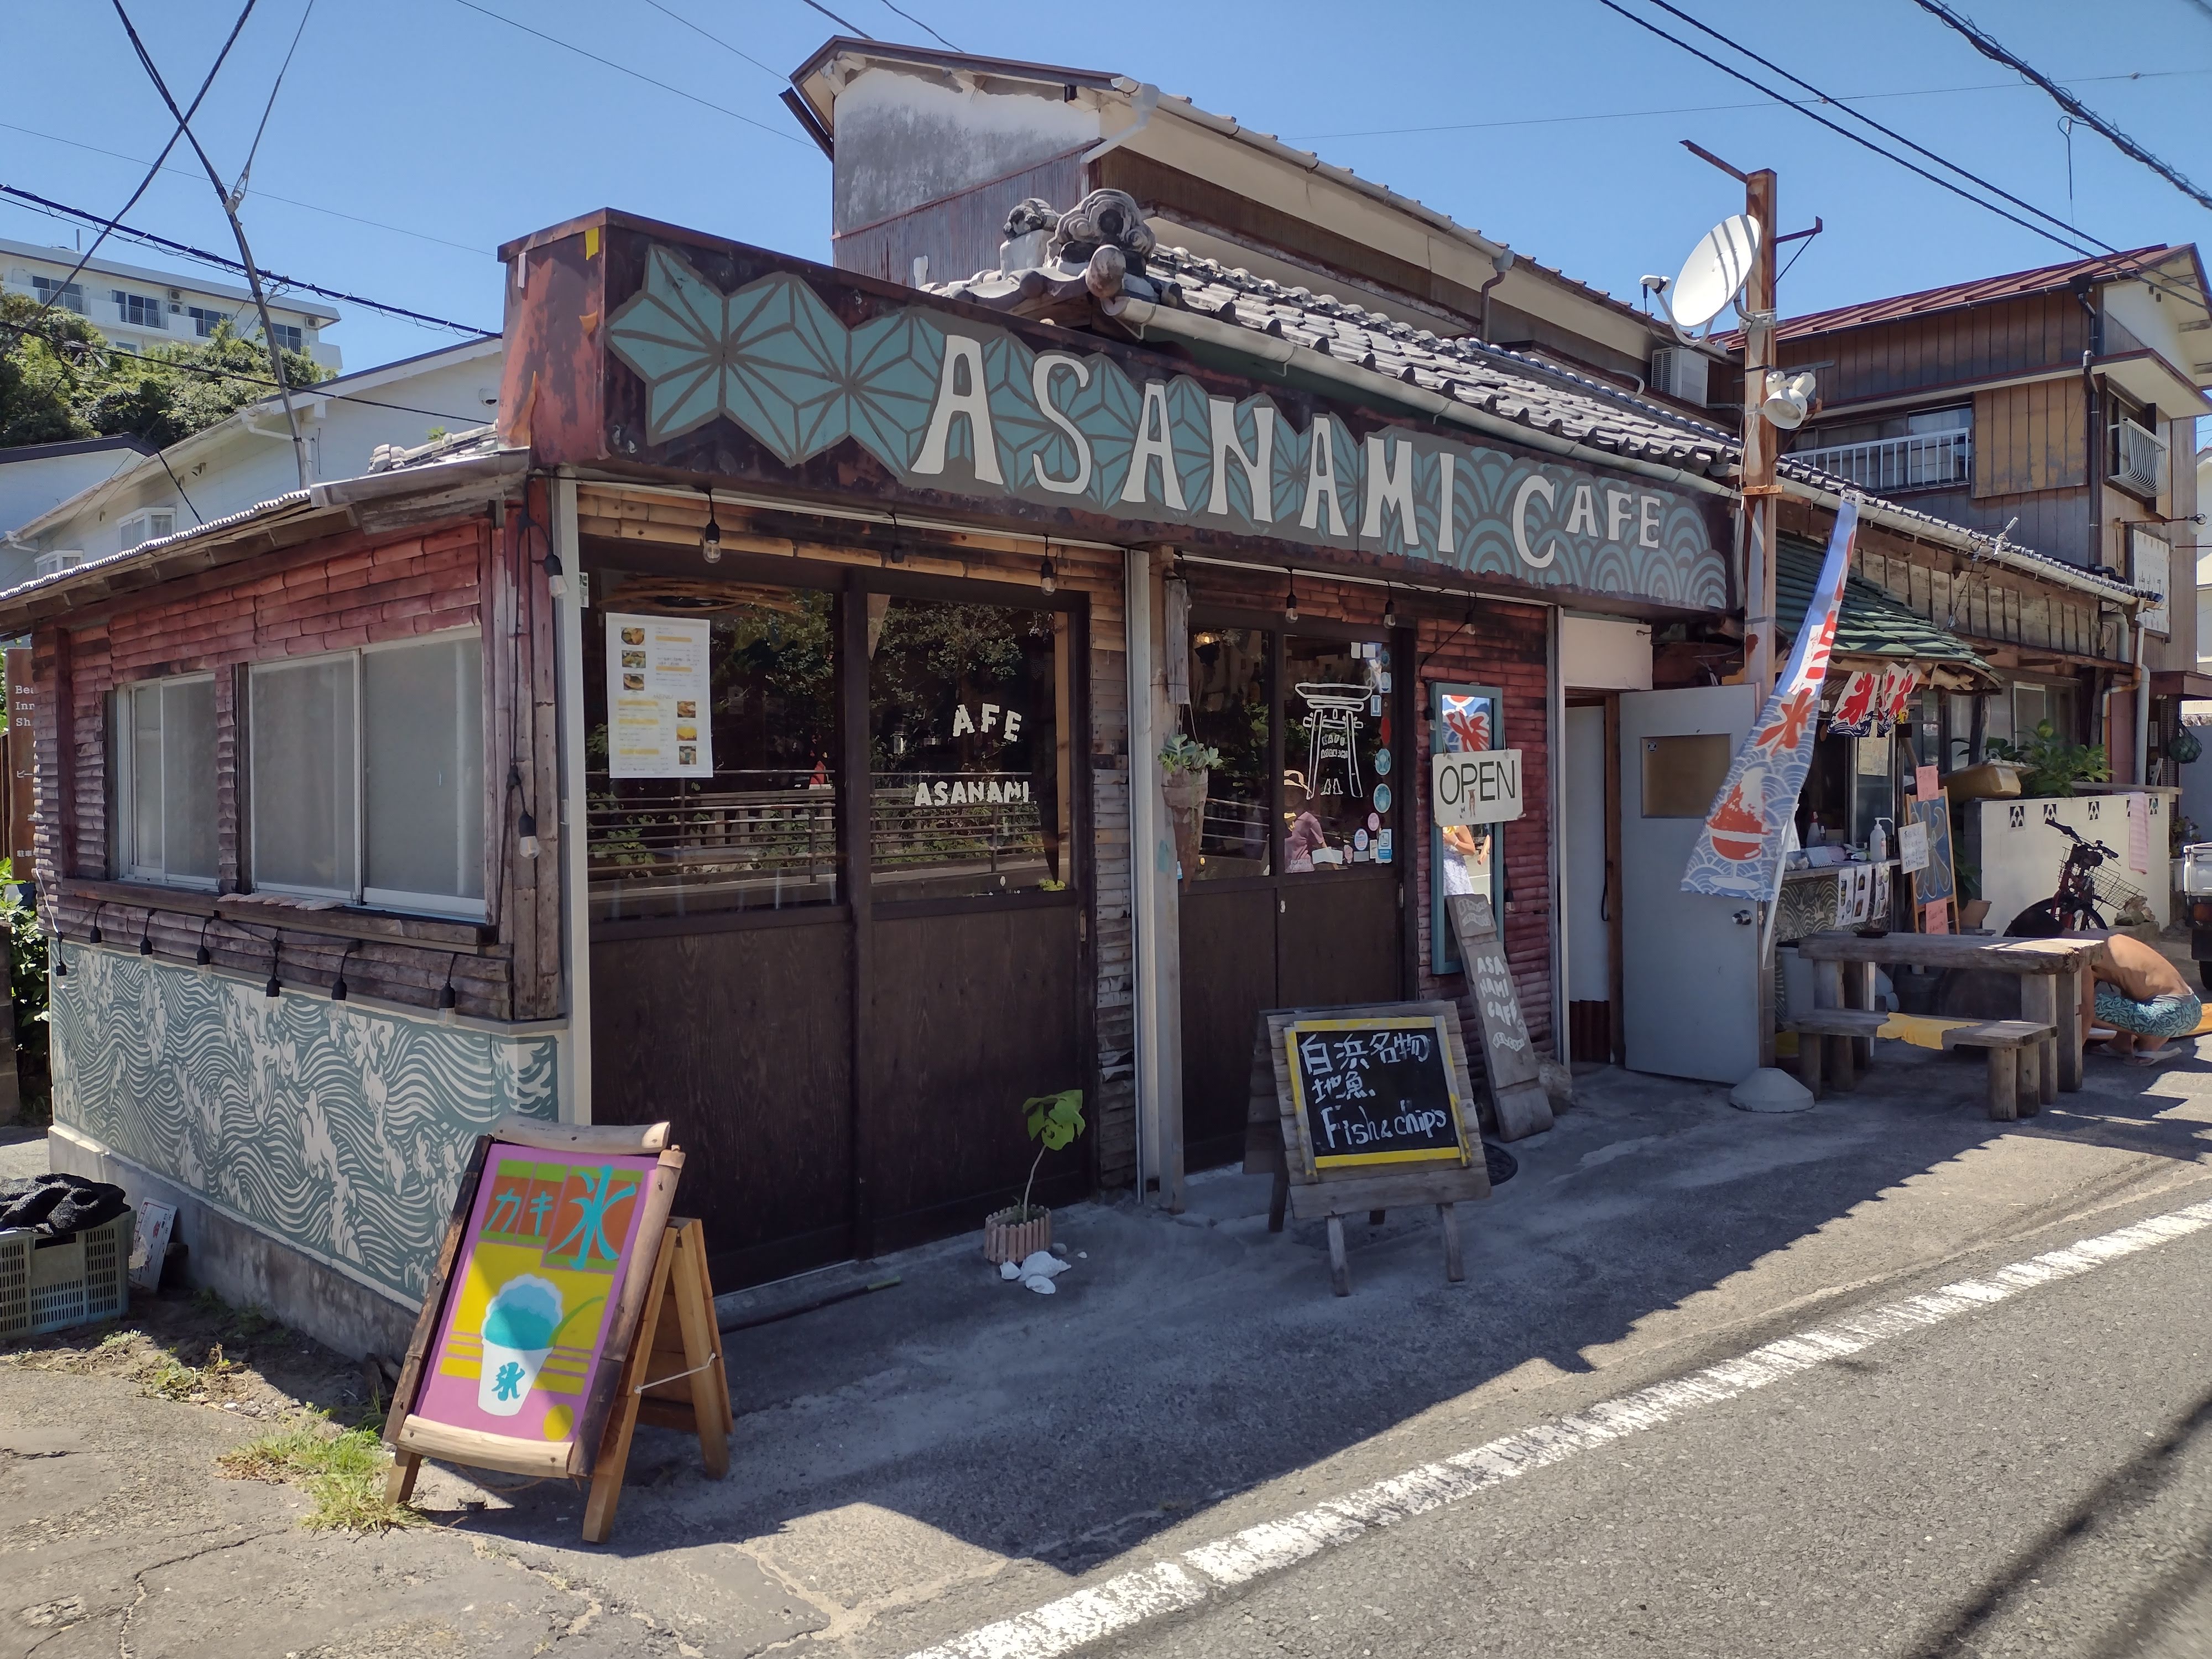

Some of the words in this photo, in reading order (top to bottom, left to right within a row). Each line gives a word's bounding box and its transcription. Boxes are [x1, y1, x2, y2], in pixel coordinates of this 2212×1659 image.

[911, 335, 1454, 553] ASANAMI
[1512, 474, 1661, 568] CAFE
[952, 703, 1022, 742] AFE
[914, 781, 1029, 807] ASANAMI
[1439, 759, 1516, 806] OPEN
[1478, 956, 1505, 975] ASA
[1479, 978, 1509, 998] NAMI
[1487, 998, 1517, 1026] CAFE
[492, 1361, 526, 1401] 氷
